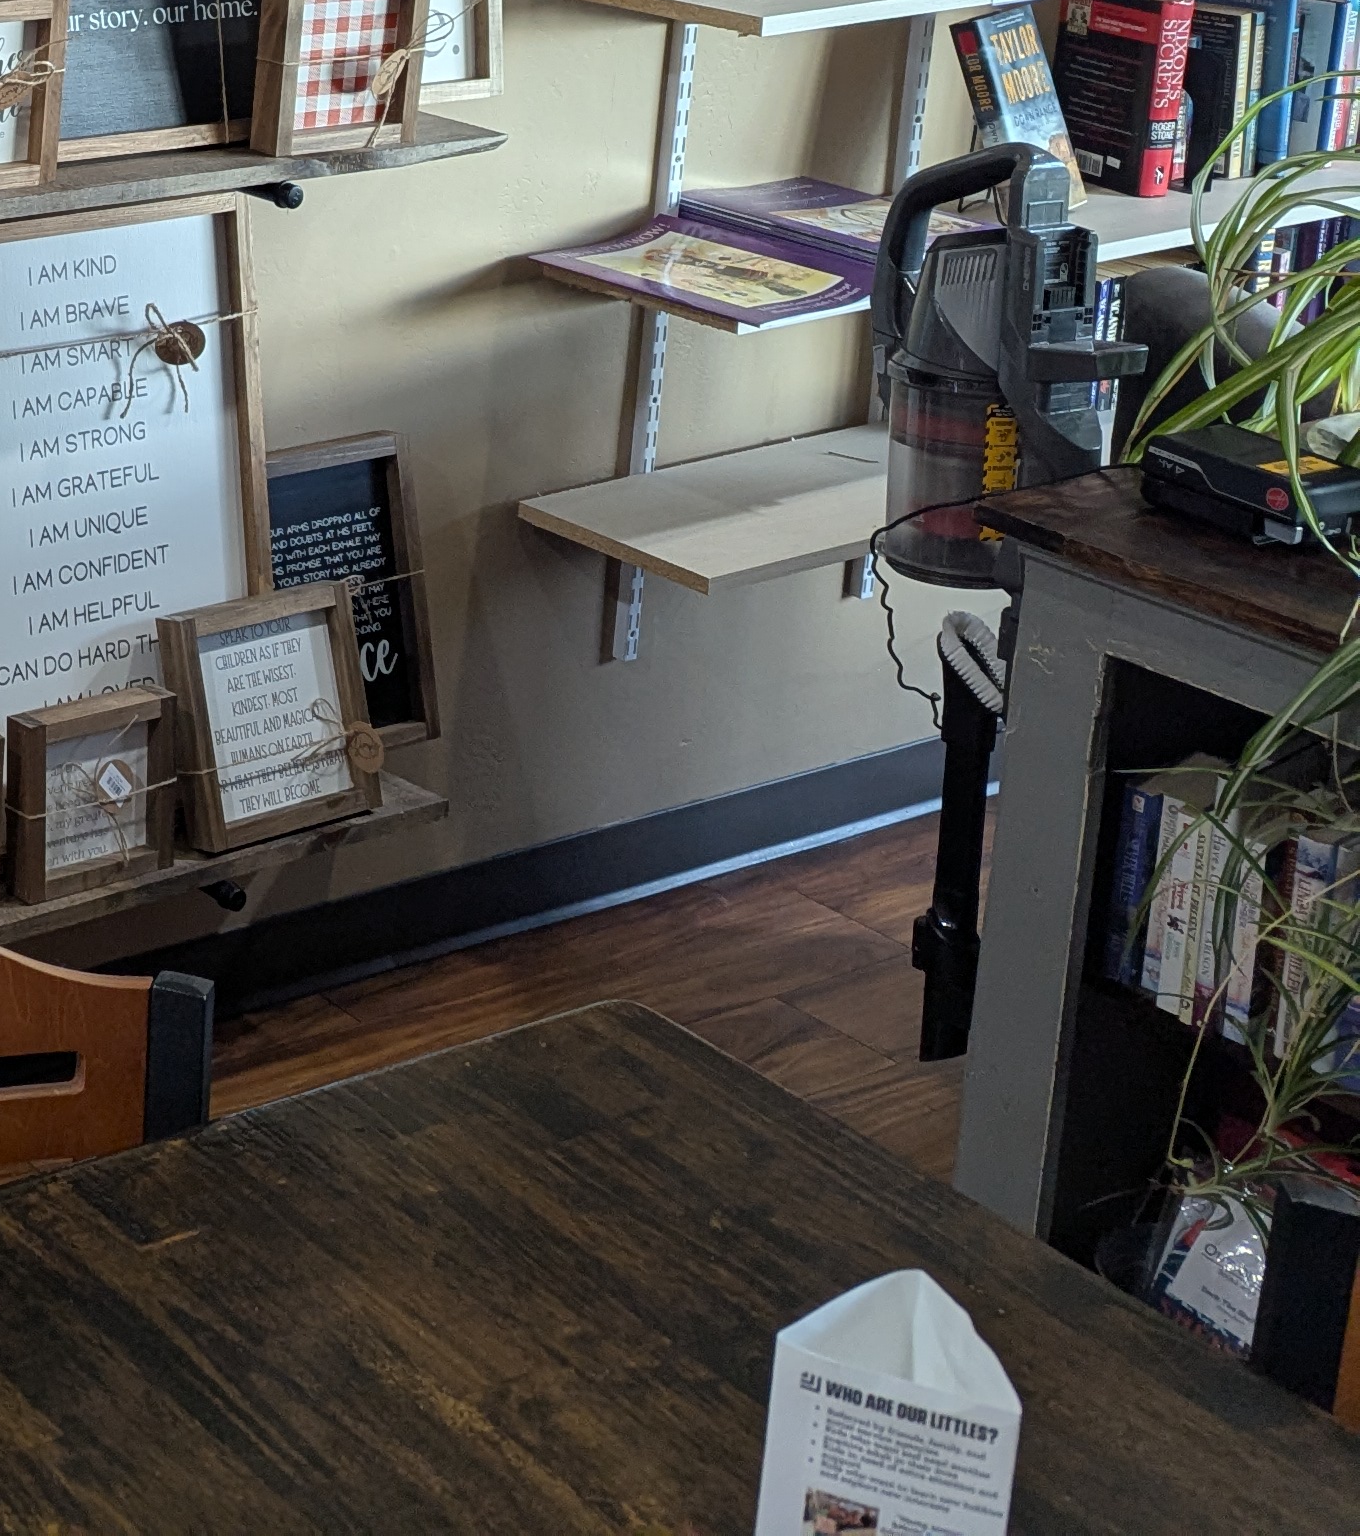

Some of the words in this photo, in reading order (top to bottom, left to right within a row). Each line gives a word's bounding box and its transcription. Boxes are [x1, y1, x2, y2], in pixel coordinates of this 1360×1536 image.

[90, 9, 147, 32] story.
[153, 6, 188, 24] our
[990, 24, 1040, 65] TAYLOR
[1154, 19, 1178, 109] SECRETS
[1170, 18, 1191, 101] NIXON'S
[1002, 63, 1050, 104] MOORE
[1152, 121, 1176, 131] ROGER
[29, 267, 32, 286] I
[38, 262, 67, 284] AM
[73, 255, 116, 279] KIND
[14, 576, 17, 595] I
[23, 569, 52, 593] AM
[59, 544, 168, 584] CONFIDENT
[215, 647, 257, 671] CHILDREN
[259, 644, 271, 659] AS
[272, 643, 280, 656] IF
[282, 638, 302, 654] THEY
[825, 1380, 862, 1403] WHO
[865, 1390, 893, 1416] ARE
[897, 1402, 928, 1425] OUR
[930, 1412, 998, 1444] LITTLES?
